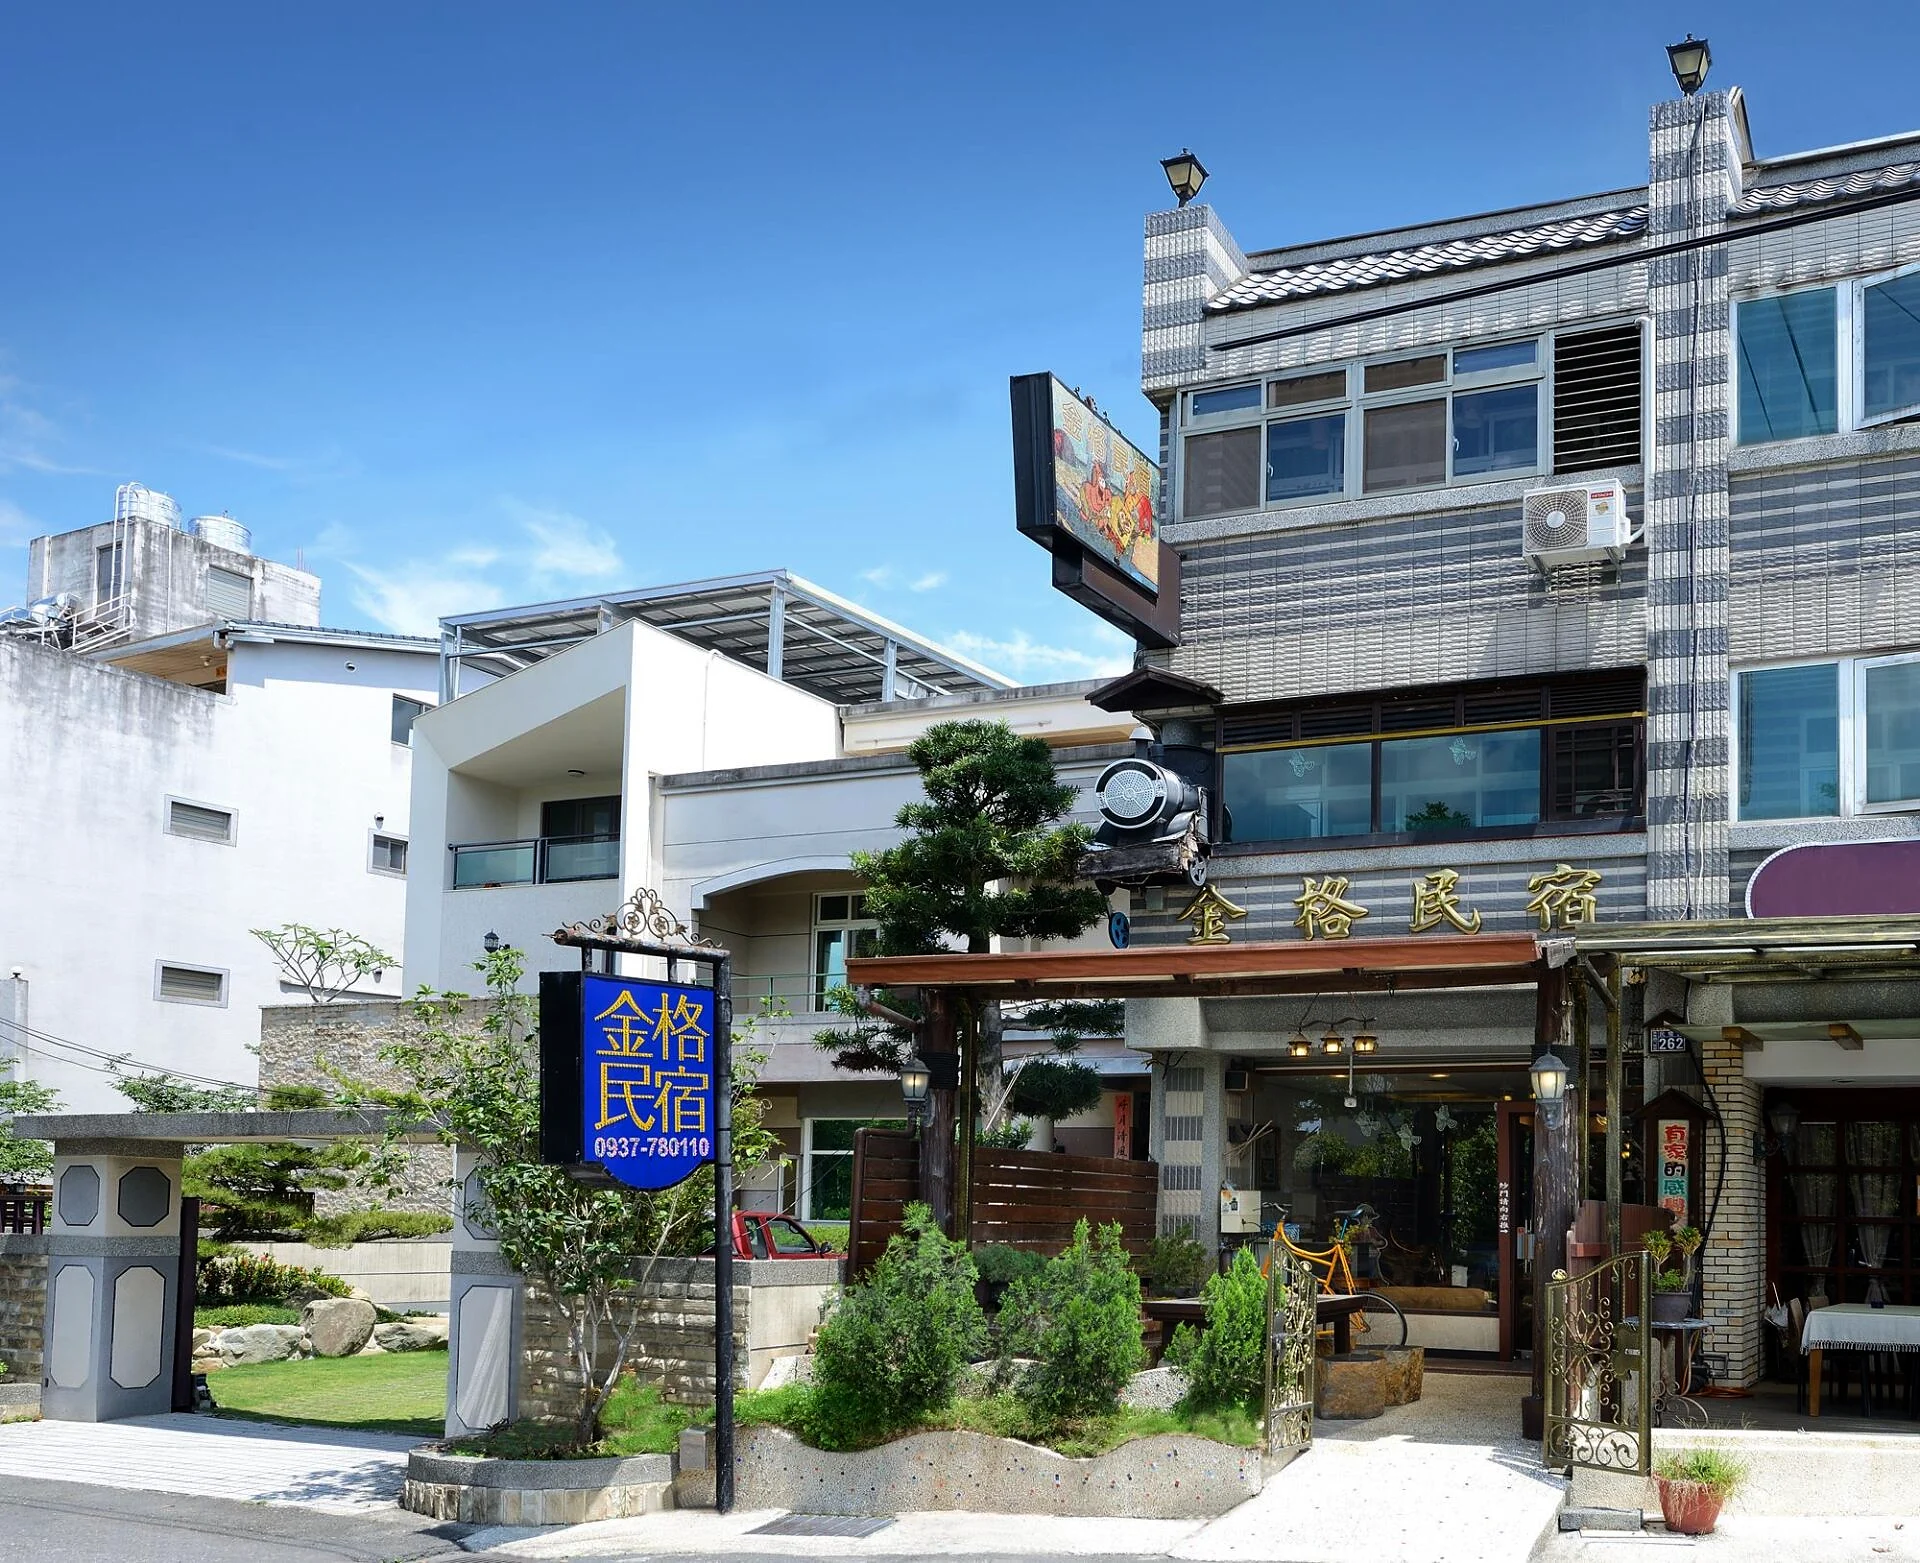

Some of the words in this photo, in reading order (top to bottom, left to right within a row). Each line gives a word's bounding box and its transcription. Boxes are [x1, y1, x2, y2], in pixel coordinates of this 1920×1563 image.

[1178, 863, 1602, 945] 金格民宿
[594, 990, 710, 1062] 金格
[1659, 1037, 1684, 1050] 262
[594, 1062, 709, 1133] 民宿
[594, 1137, 710, 1157] 0937-780110
